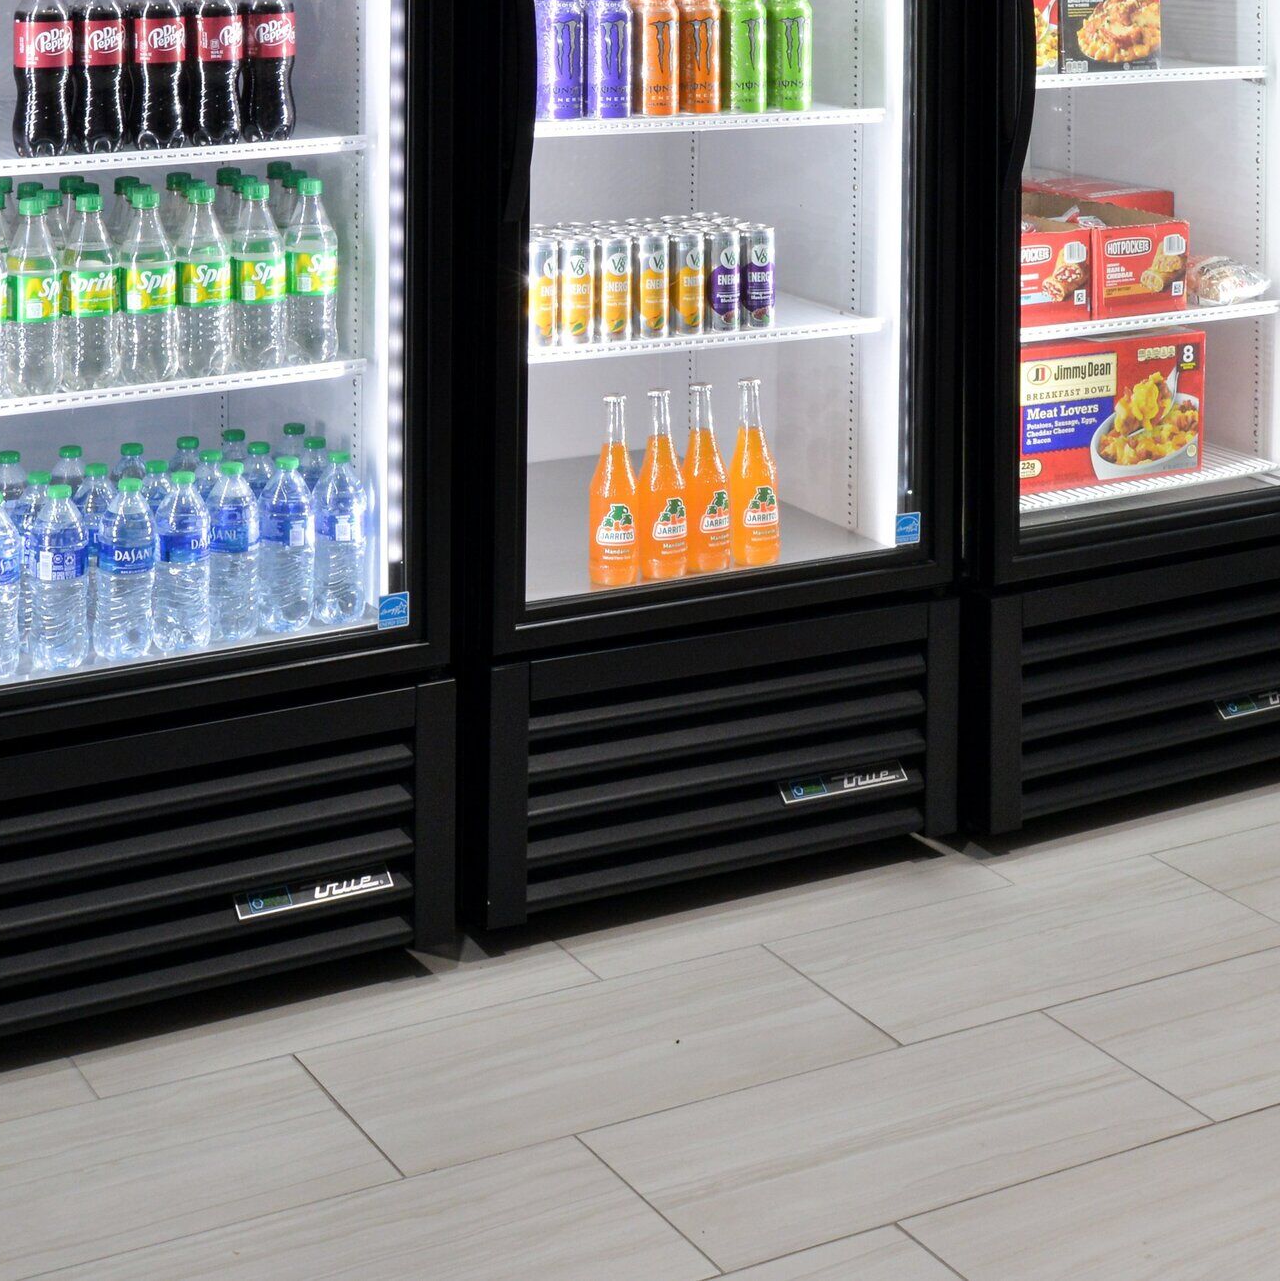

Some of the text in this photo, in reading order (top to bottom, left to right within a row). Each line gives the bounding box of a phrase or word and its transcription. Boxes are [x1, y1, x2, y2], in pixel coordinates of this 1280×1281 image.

[103, 27, 117, 39] Dr
[162, 25, 176, 36] Dr
[269, 21, 283, 33] Dr
[40, 33, 71, 50] Peppe
[51, 28, 65, 41] Dr
[92, 30, 119, 49] Peppe
[1107, 240, 1149, 255] HOT POCKETS
[653, 255, 664, 270] V8
[725, 251, 736, 266] V8
[754, 249, 768, 265] V8
[571, 259, 585, 275] V8
[612, 257, 626, 273] V8
[748, 272, 773, 283] ENERG
[607, 282, 627, 292] ENERG
[1183, 345, 1193, 362] 8
[1054, 362, 1110, 382] Jimmy Dean
[1027, 385, 1111, 401] BREAKFAST BOWL
[1027, 404, 1099, 420] Meat Lovers
[1027, 417, 1097, 430] Potatoes, Sausage, Eggs,
[1027, 427, 1075, 438] Cheddar Cheese
[1033, 437, 1051, 445] Bacon
[1021, 462, 1035, 470] 22g
[600, 531, 633, 540] JARRITOS
[657, 524, 686, 535] JARRIT
